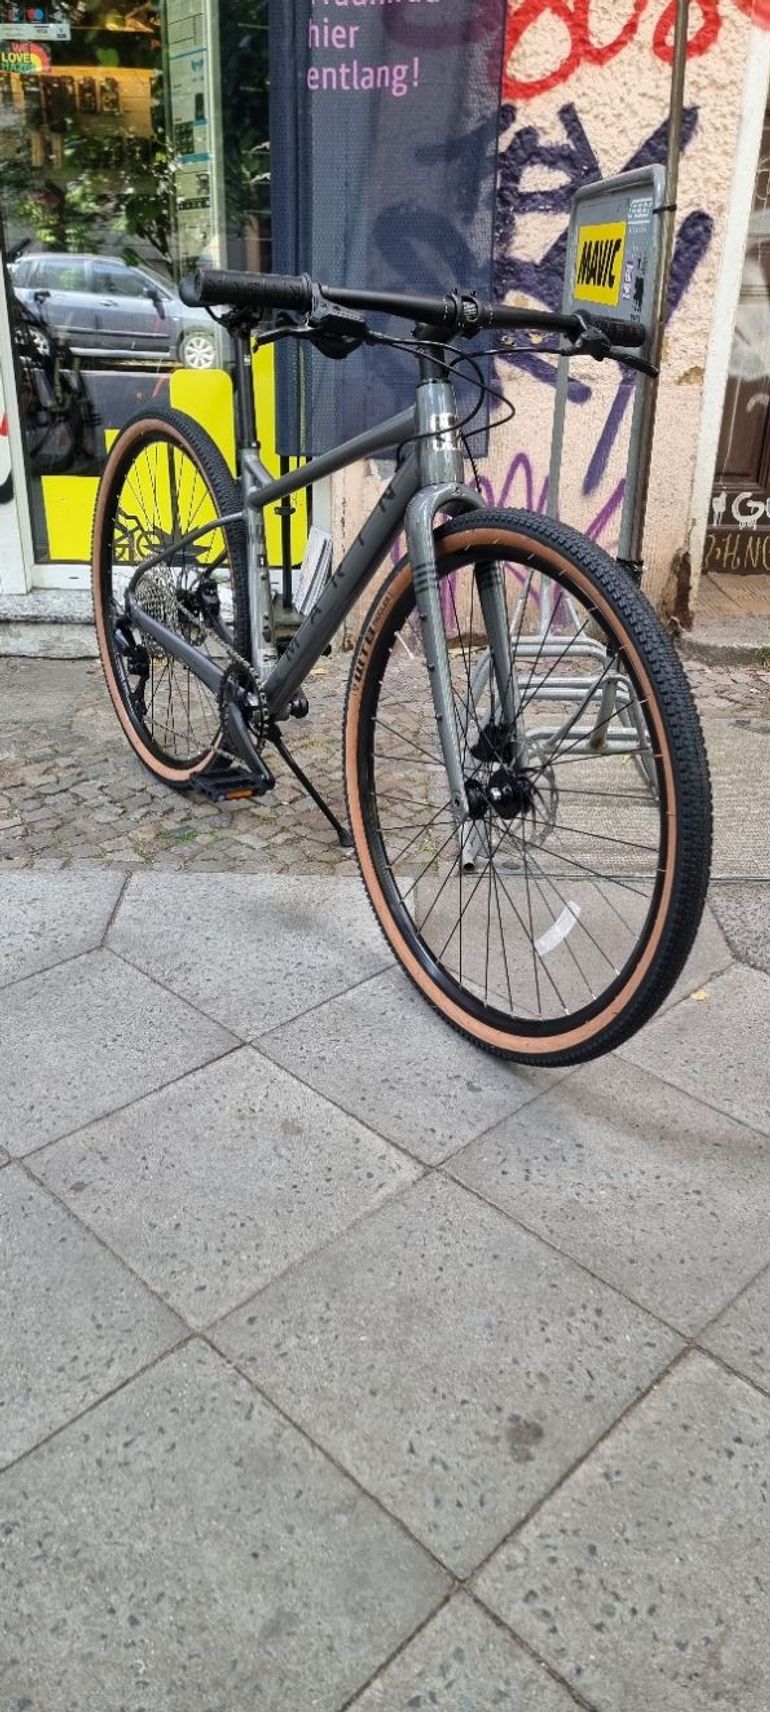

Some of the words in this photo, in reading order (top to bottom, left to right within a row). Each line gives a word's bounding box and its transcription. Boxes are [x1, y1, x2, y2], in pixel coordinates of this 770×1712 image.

[308, 17, 359, 48] hier
[2, 52, 31, 64] LOVE
[307, 57, 419, 97] entlang!
[577, 238, 622, 289] MAVIC
[286, 481, 396, 663] MARIN
[354, 625, 376, 683] WTB
